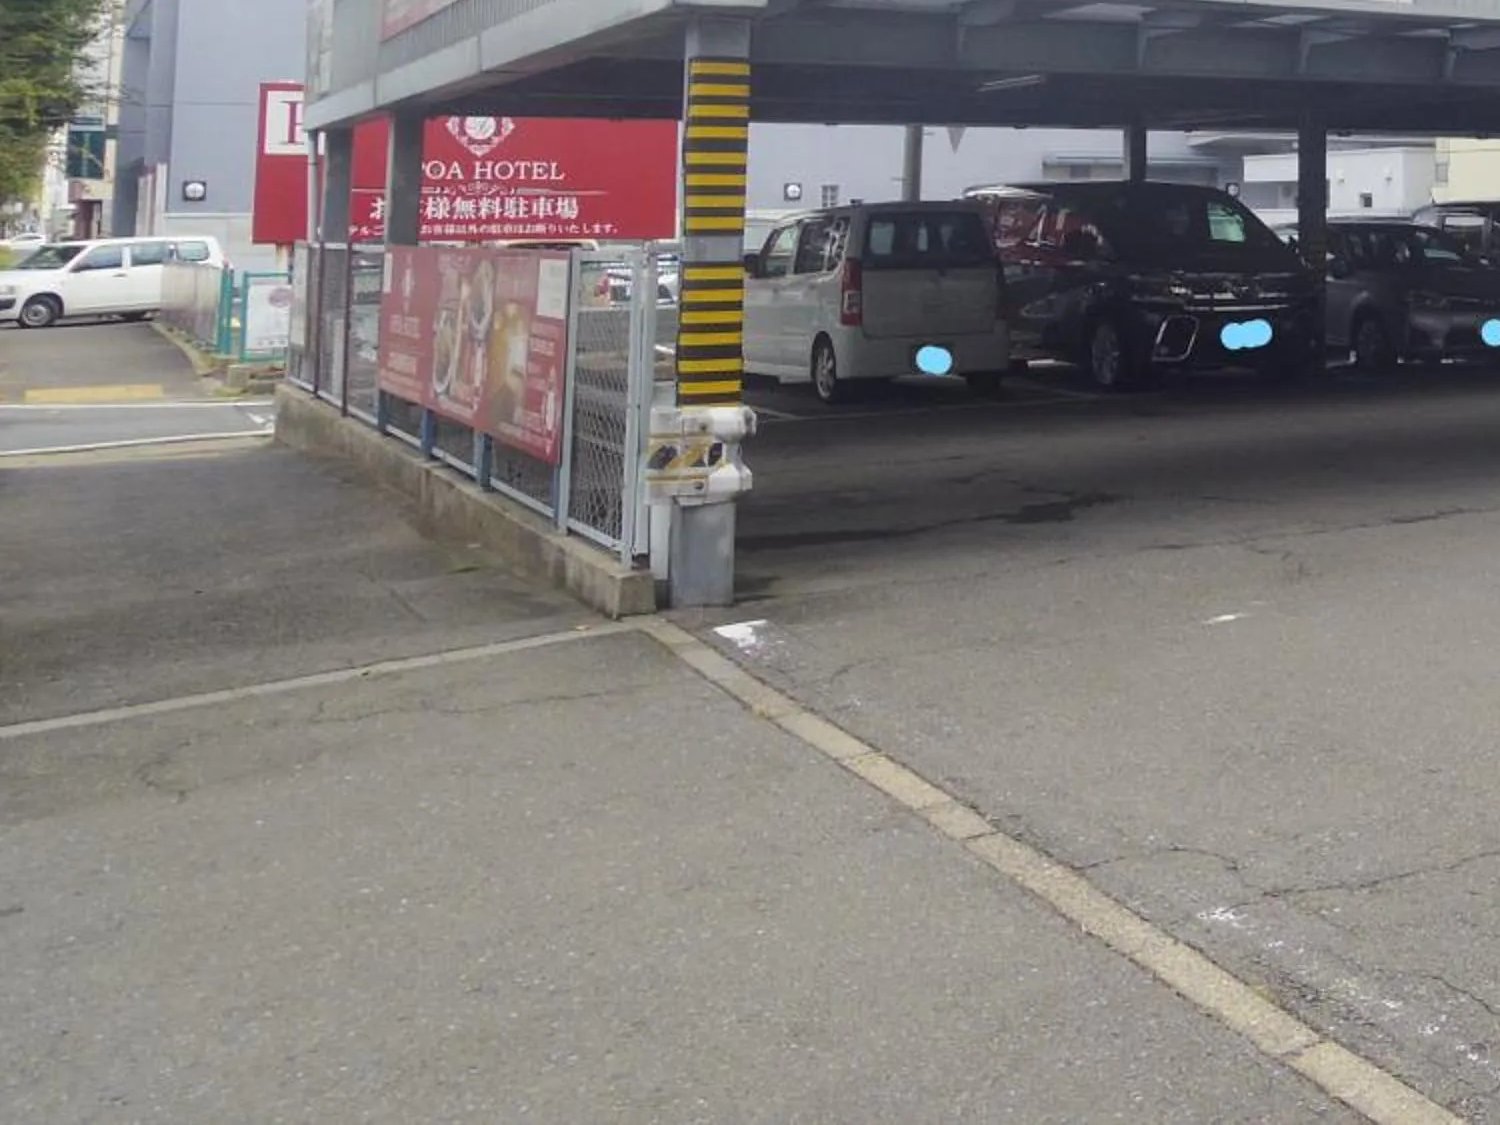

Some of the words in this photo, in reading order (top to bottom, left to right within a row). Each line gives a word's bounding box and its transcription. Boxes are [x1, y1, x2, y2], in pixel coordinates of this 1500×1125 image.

[421, 160, 465, 180] OA
[474, 160, 565, 181] HOTEL
[370, 196, 579, 221] お様無料駐車場
